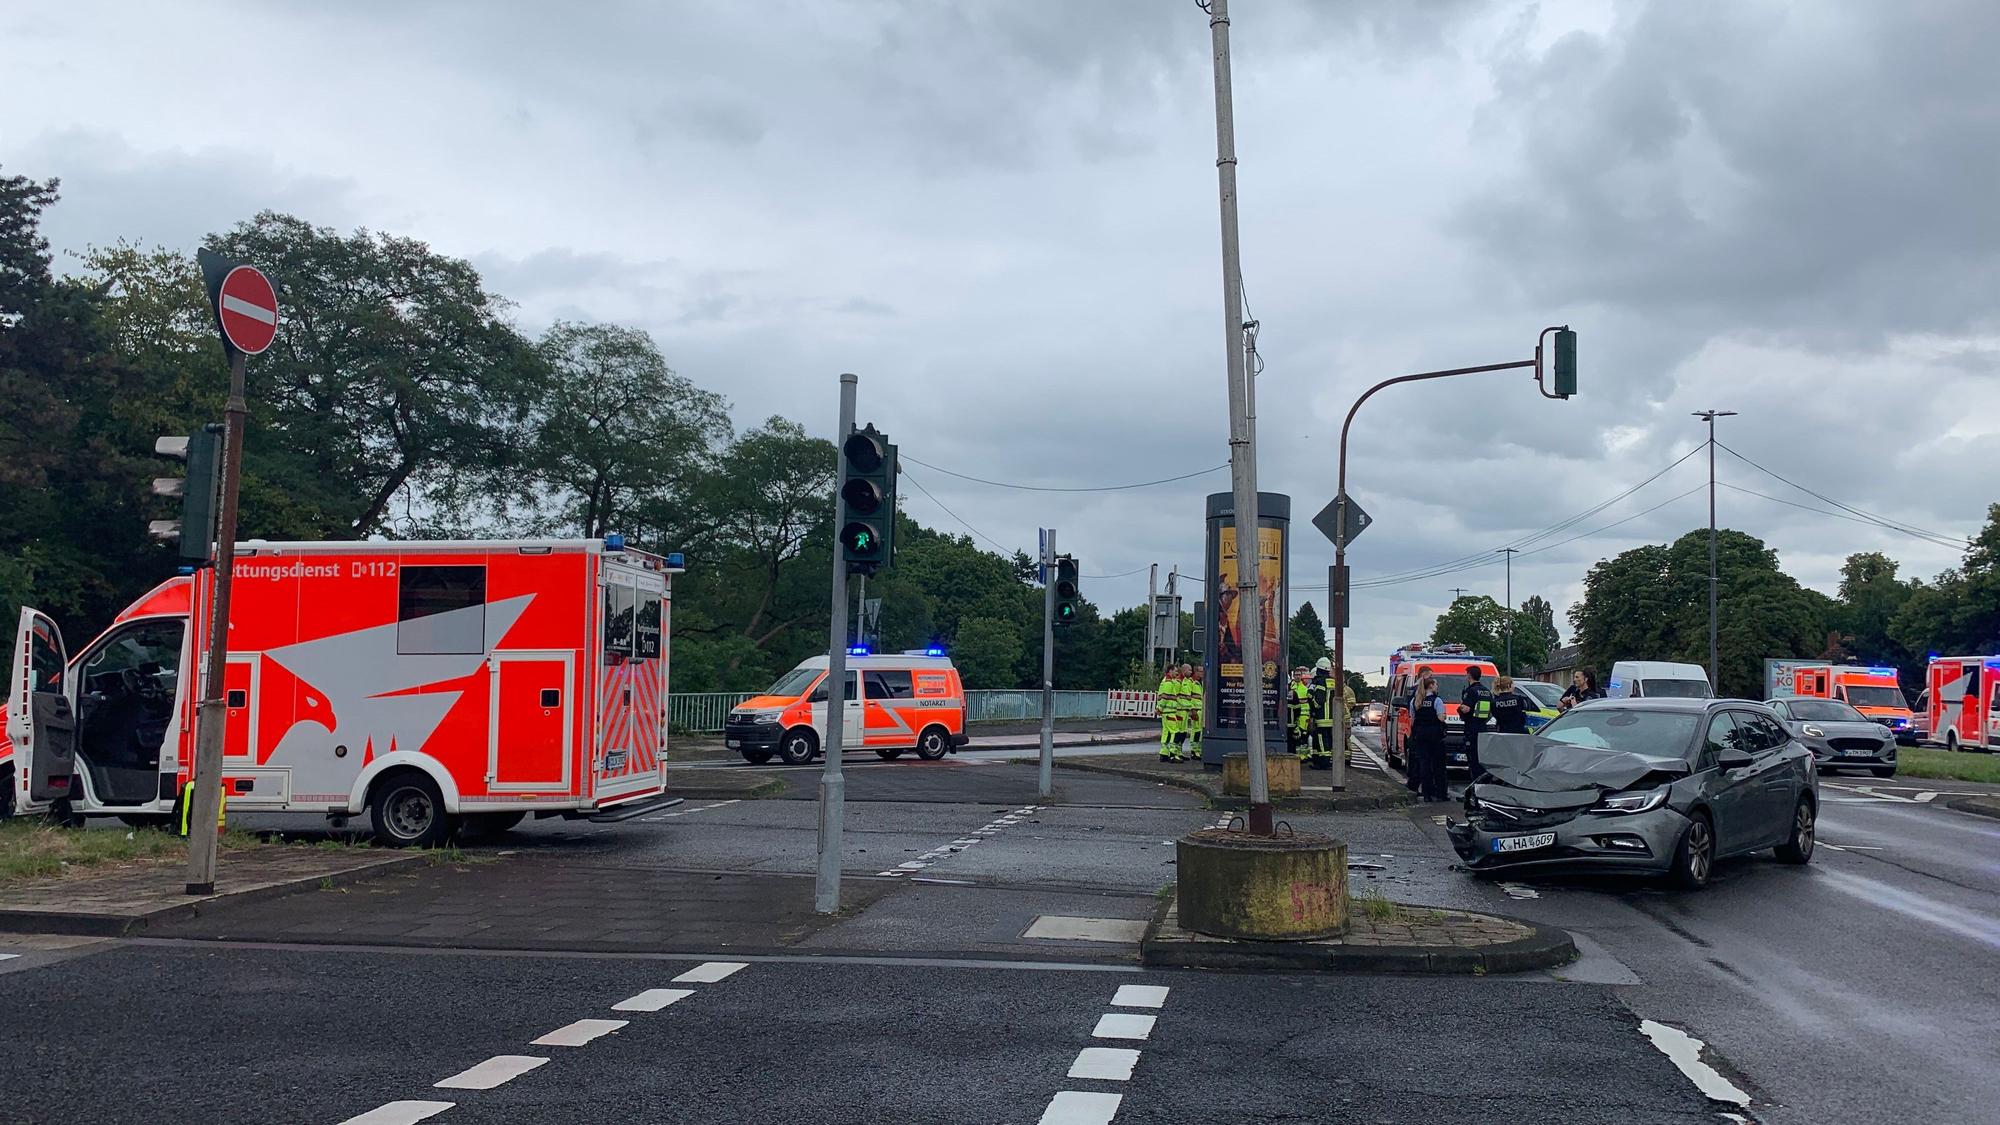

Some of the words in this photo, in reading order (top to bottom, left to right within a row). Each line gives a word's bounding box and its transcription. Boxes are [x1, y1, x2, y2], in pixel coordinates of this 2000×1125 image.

[1223, 541, 1280, 556] POPEJI
[231, 562, 340, 581] ttungsdienst
[369, 561, 396, 577] 112
[919, 699, 946, 707] NOTARZT
[1495, 699, 1518, 708] POLIZEI
[1513, 837, 1528, 850] HA
